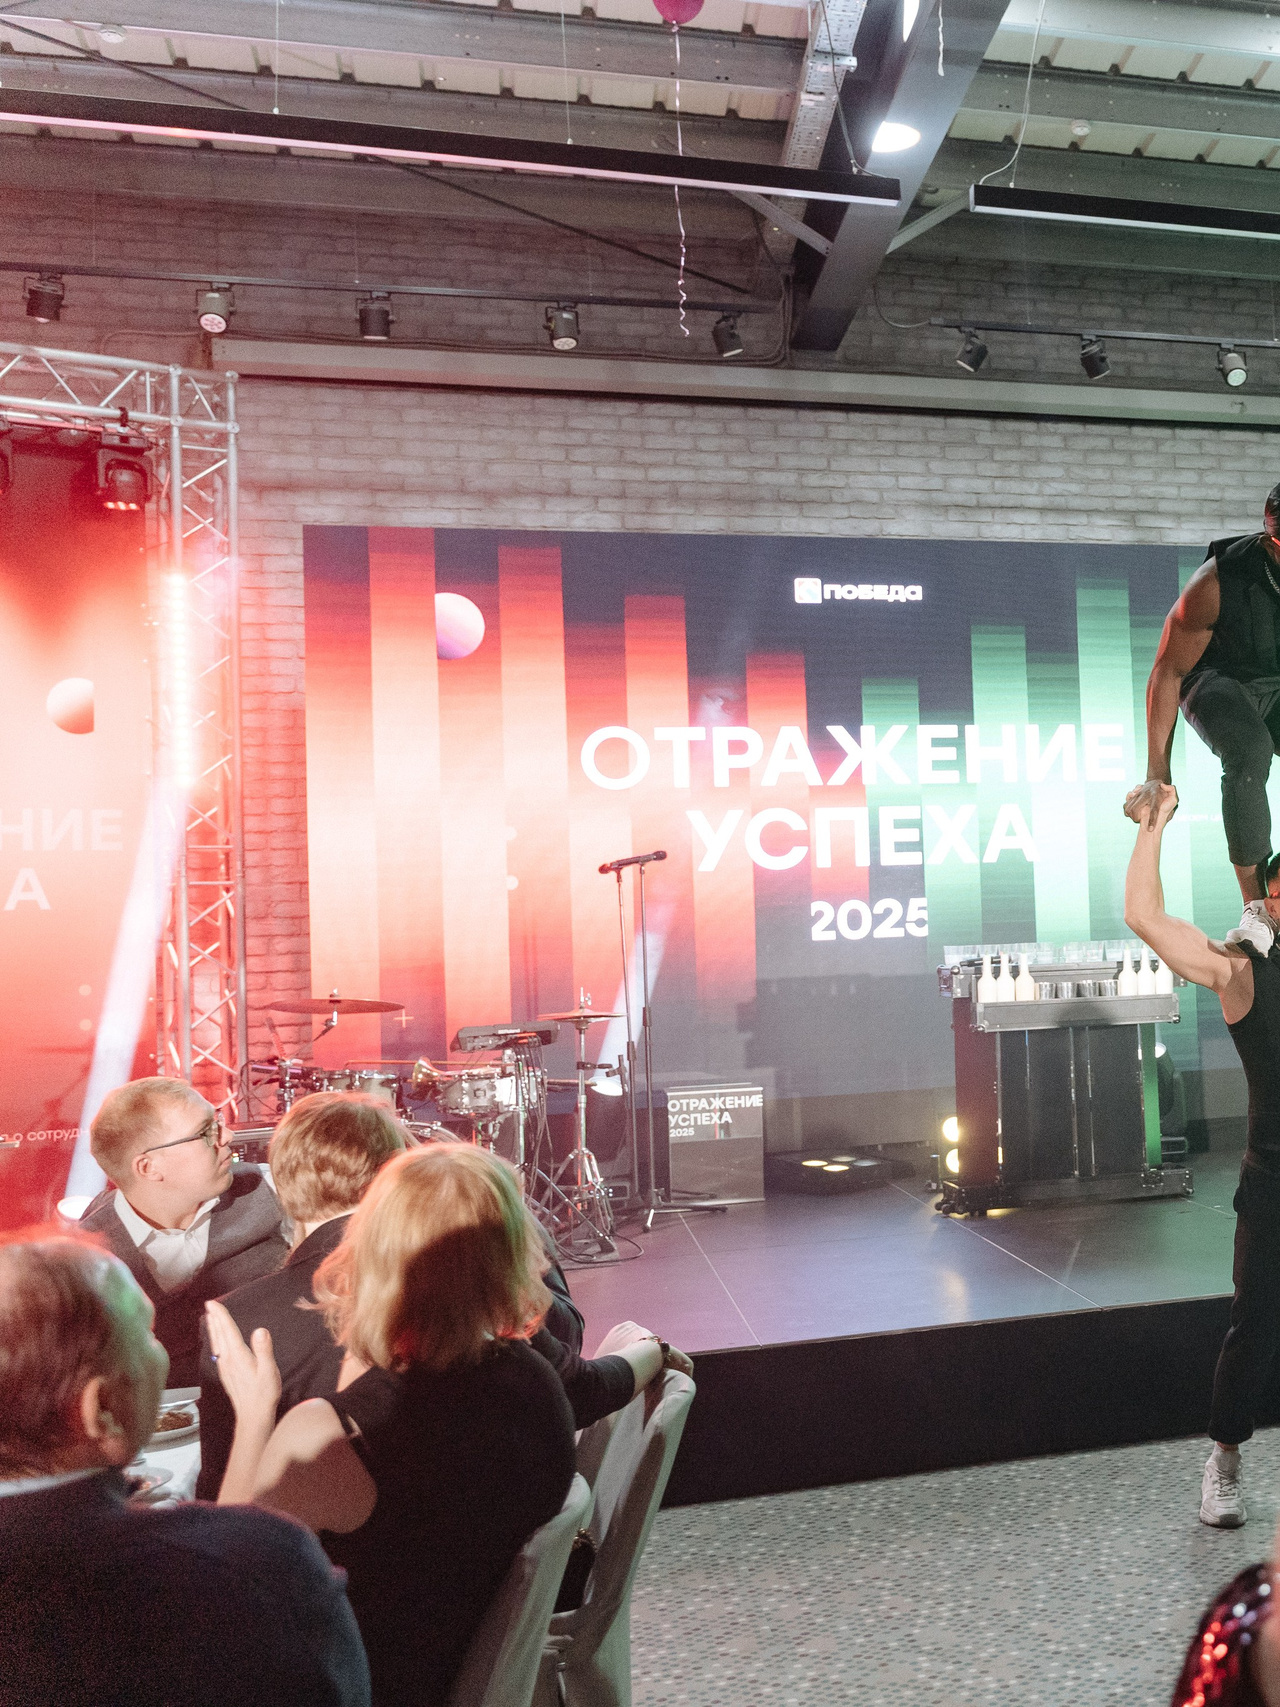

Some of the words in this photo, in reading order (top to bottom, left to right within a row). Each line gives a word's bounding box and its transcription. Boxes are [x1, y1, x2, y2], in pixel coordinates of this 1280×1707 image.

[580, 723, 1127, 790] ОТРАЖЕНИЕ
[685, 804, 1040, 872] УСПЕХА
[809, 897, 930, 942] 2025
[667, 1094, 764, 1112] ОТРАЖЕНИЕ
[668, 1111, 733, 1127] УСПЕХА
[669, 1127, 695, 1138] 2025
